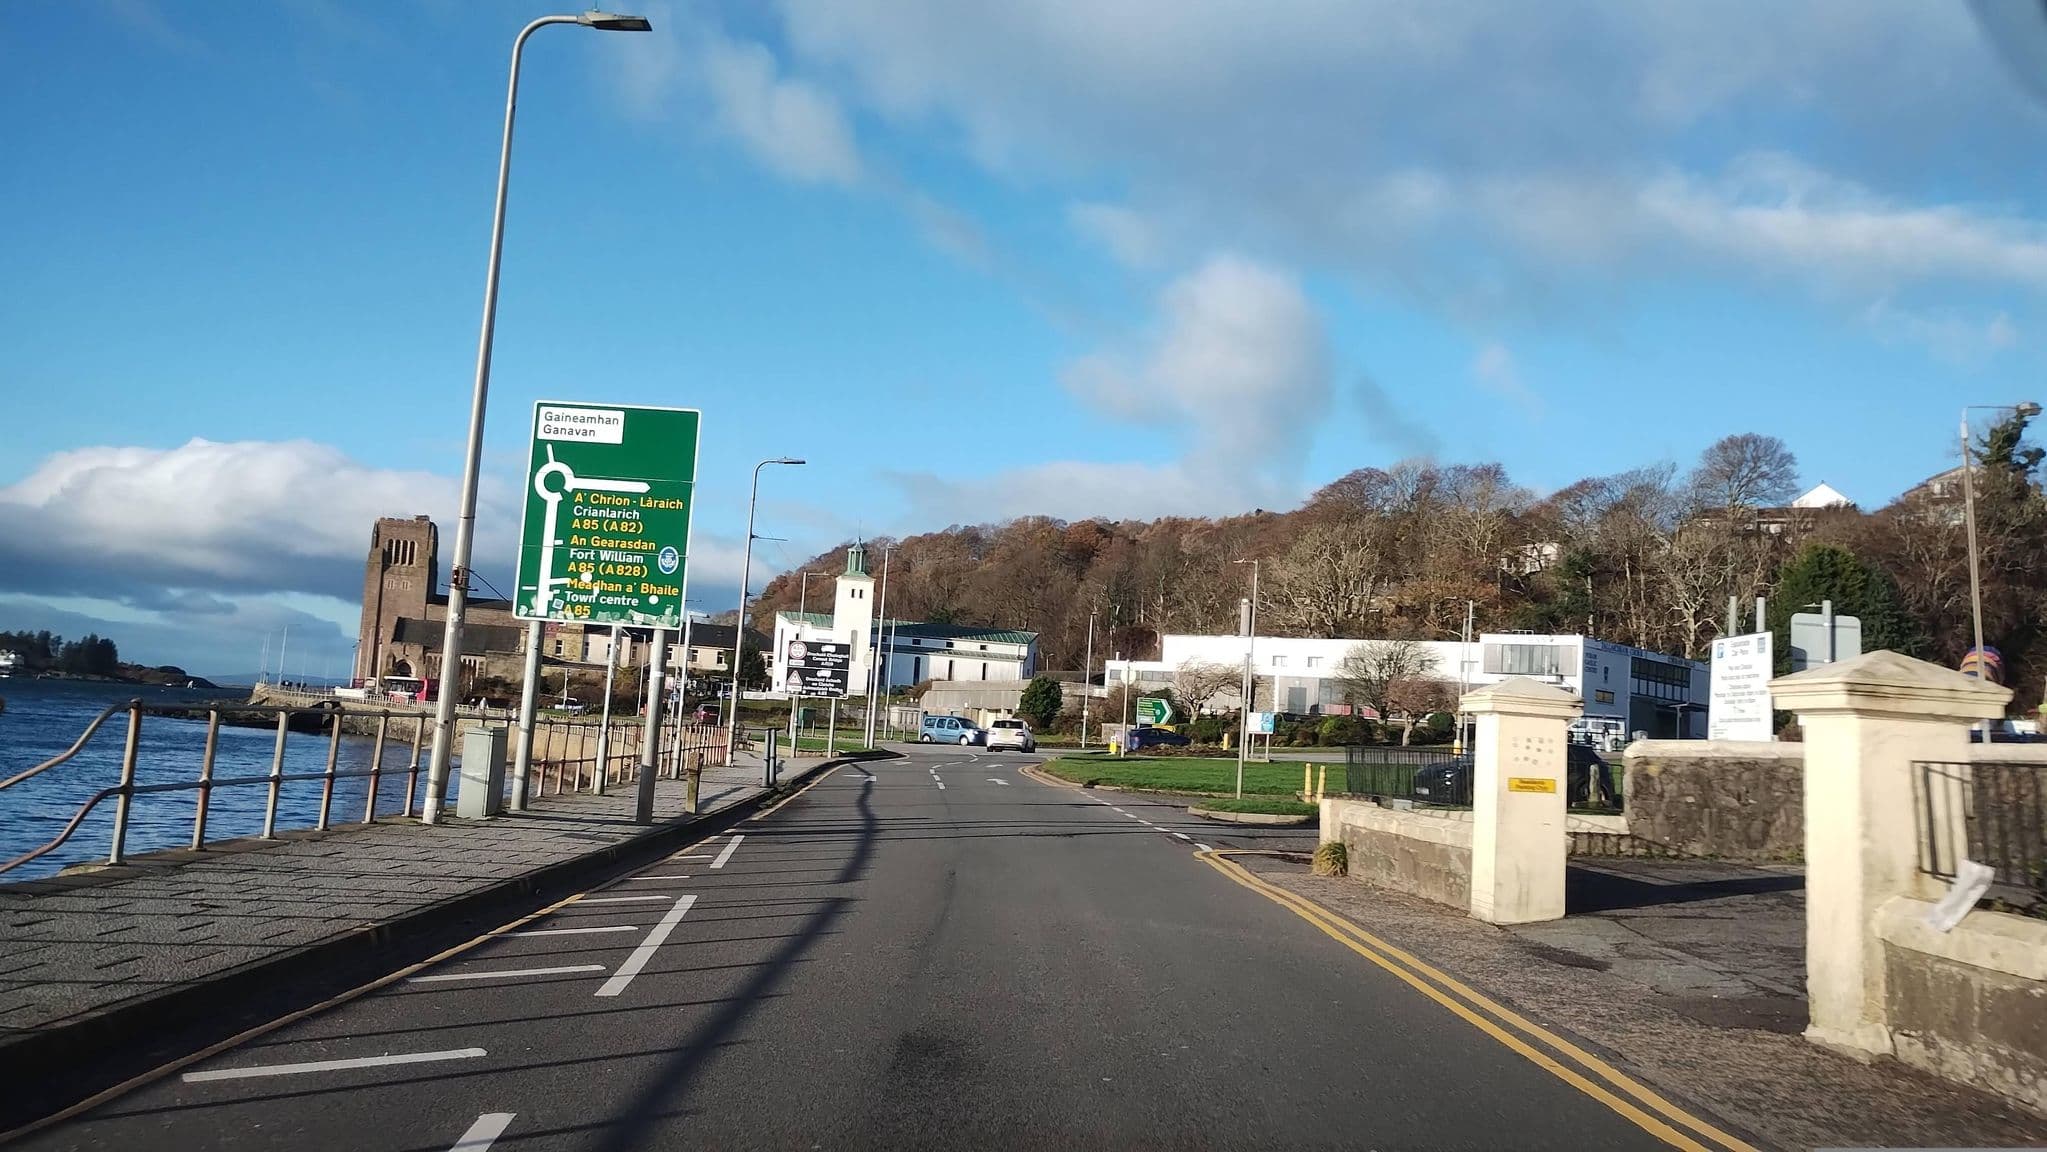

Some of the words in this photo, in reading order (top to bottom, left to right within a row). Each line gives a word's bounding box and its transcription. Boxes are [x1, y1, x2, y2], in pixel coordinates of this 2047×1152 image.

[544, 411, 619, 425] Gaineamhan
[543, 424, 596, 437] Ganavan
[640, 496, 683, 510] Làraich
[573, 505, 640, 519] Crianlarich
[570, 534, 587, 546] An
[591, 536, 656, 550] Gearasdan
[569, 548, 595, 560] Fort
[599, 550, 644, 564] William
[567, 578, 622, 592] Meadhan
[640, 582, 679, 596] Bhaile
[564, 590, 596, 603] Town
[600, 594, 639, 606] centre
